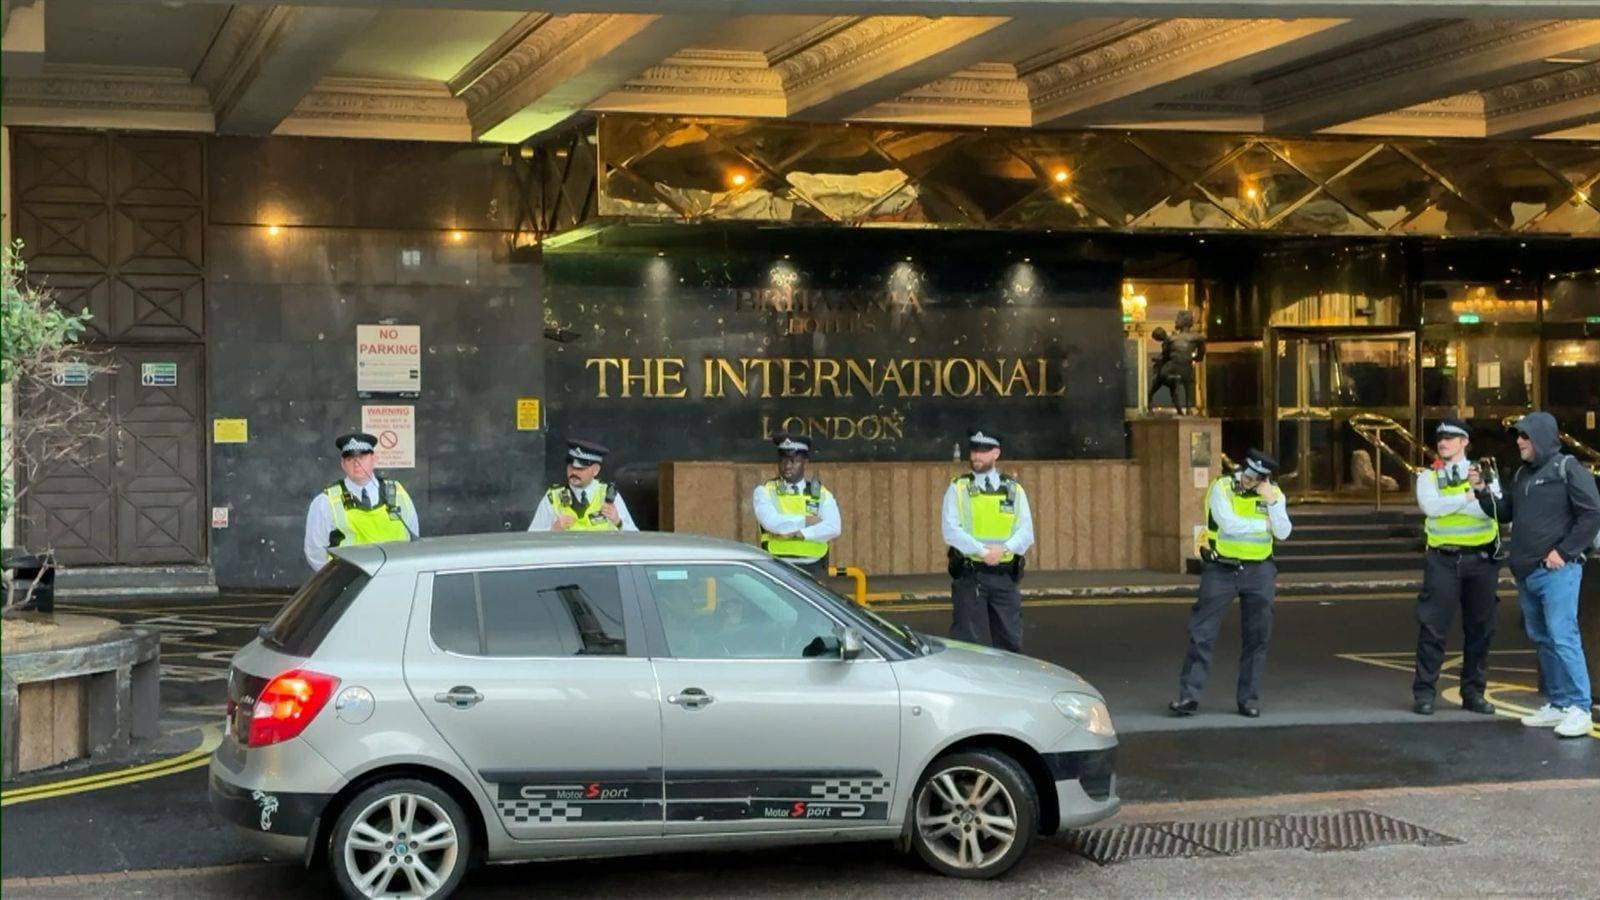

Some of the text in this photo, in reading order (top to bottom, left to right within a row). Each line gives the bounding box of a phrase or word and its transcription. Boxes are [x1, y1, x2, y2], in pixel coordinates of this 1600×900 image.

[379, 329, 399, 340] NO
[359, 343, 419, 355] PARKING
[585, 357, 1066, 399] THE INTERNATIONAL
[367, 407, 410, 416] WARNING
[762, 415, 905, 441] LONDON
